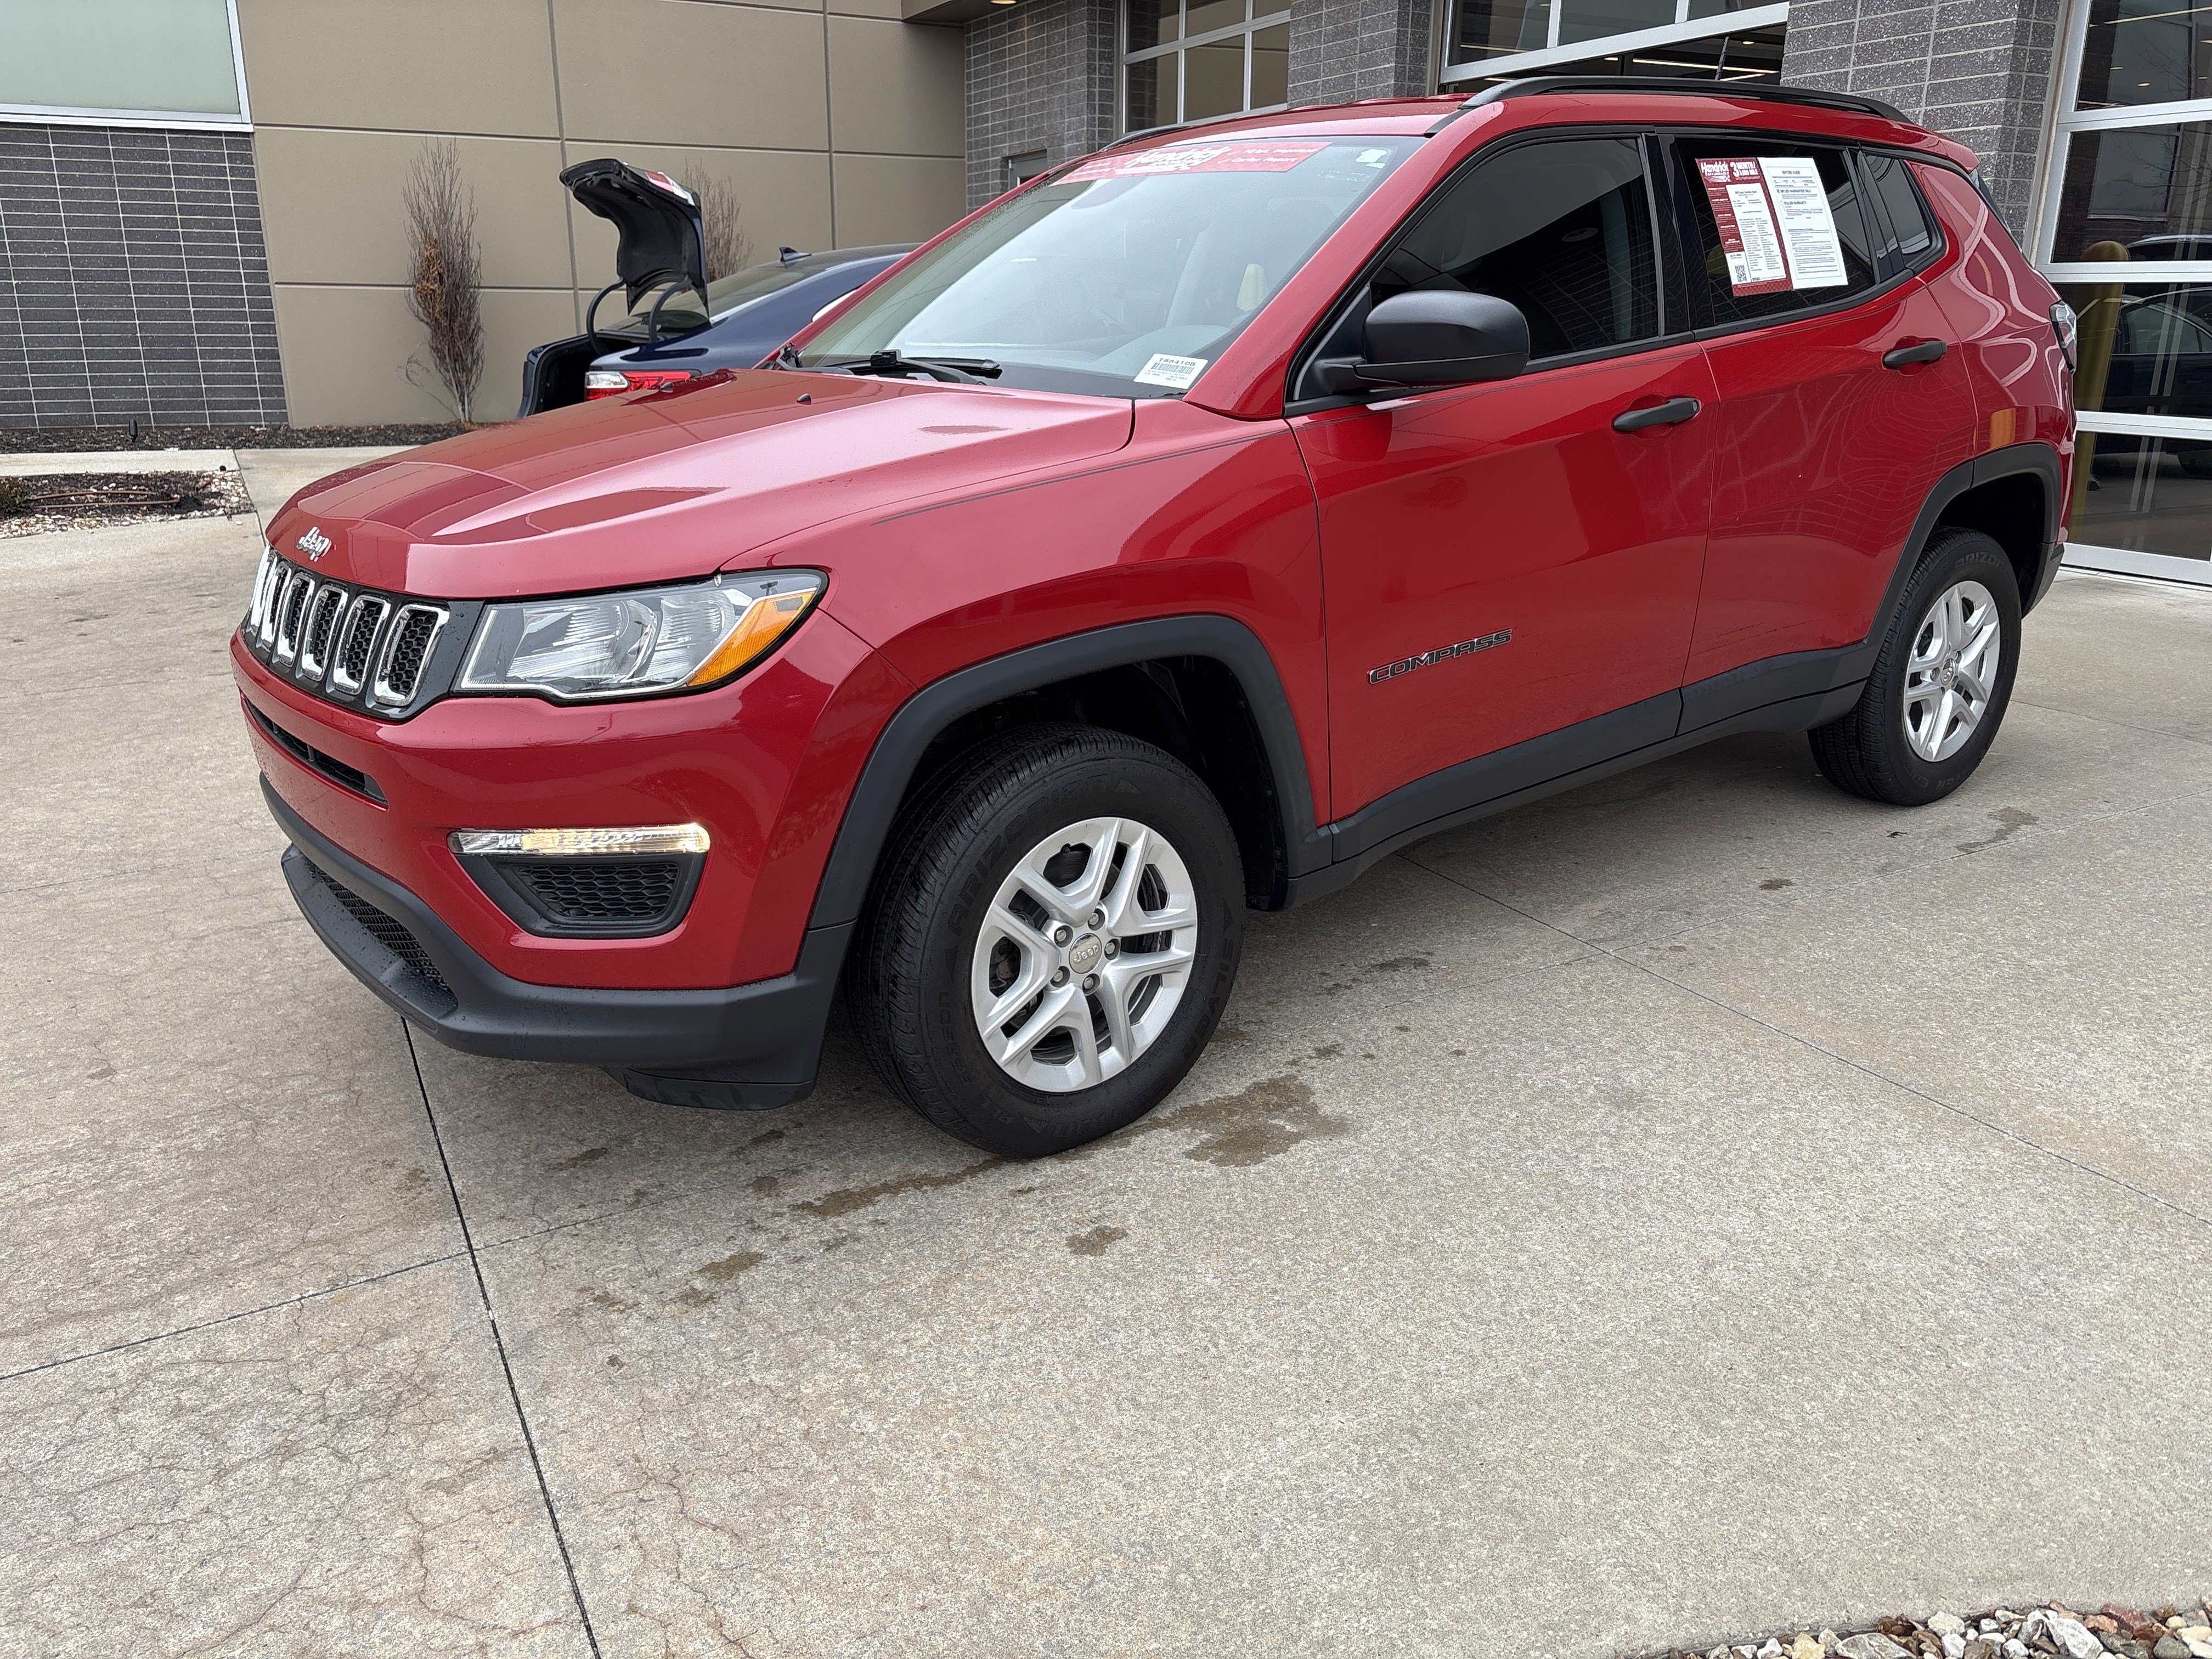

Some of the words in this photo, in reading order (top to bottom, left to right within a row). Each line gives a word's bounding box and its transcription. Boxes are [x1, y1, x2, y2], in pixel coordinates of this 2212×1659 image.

[1730, 162, 1740, 177] 3
[297, 526, 332, 562] Jeep
[1367, 629, 1512, 685] COMPASS
[1073, 944, 1099, 964] Jeep
